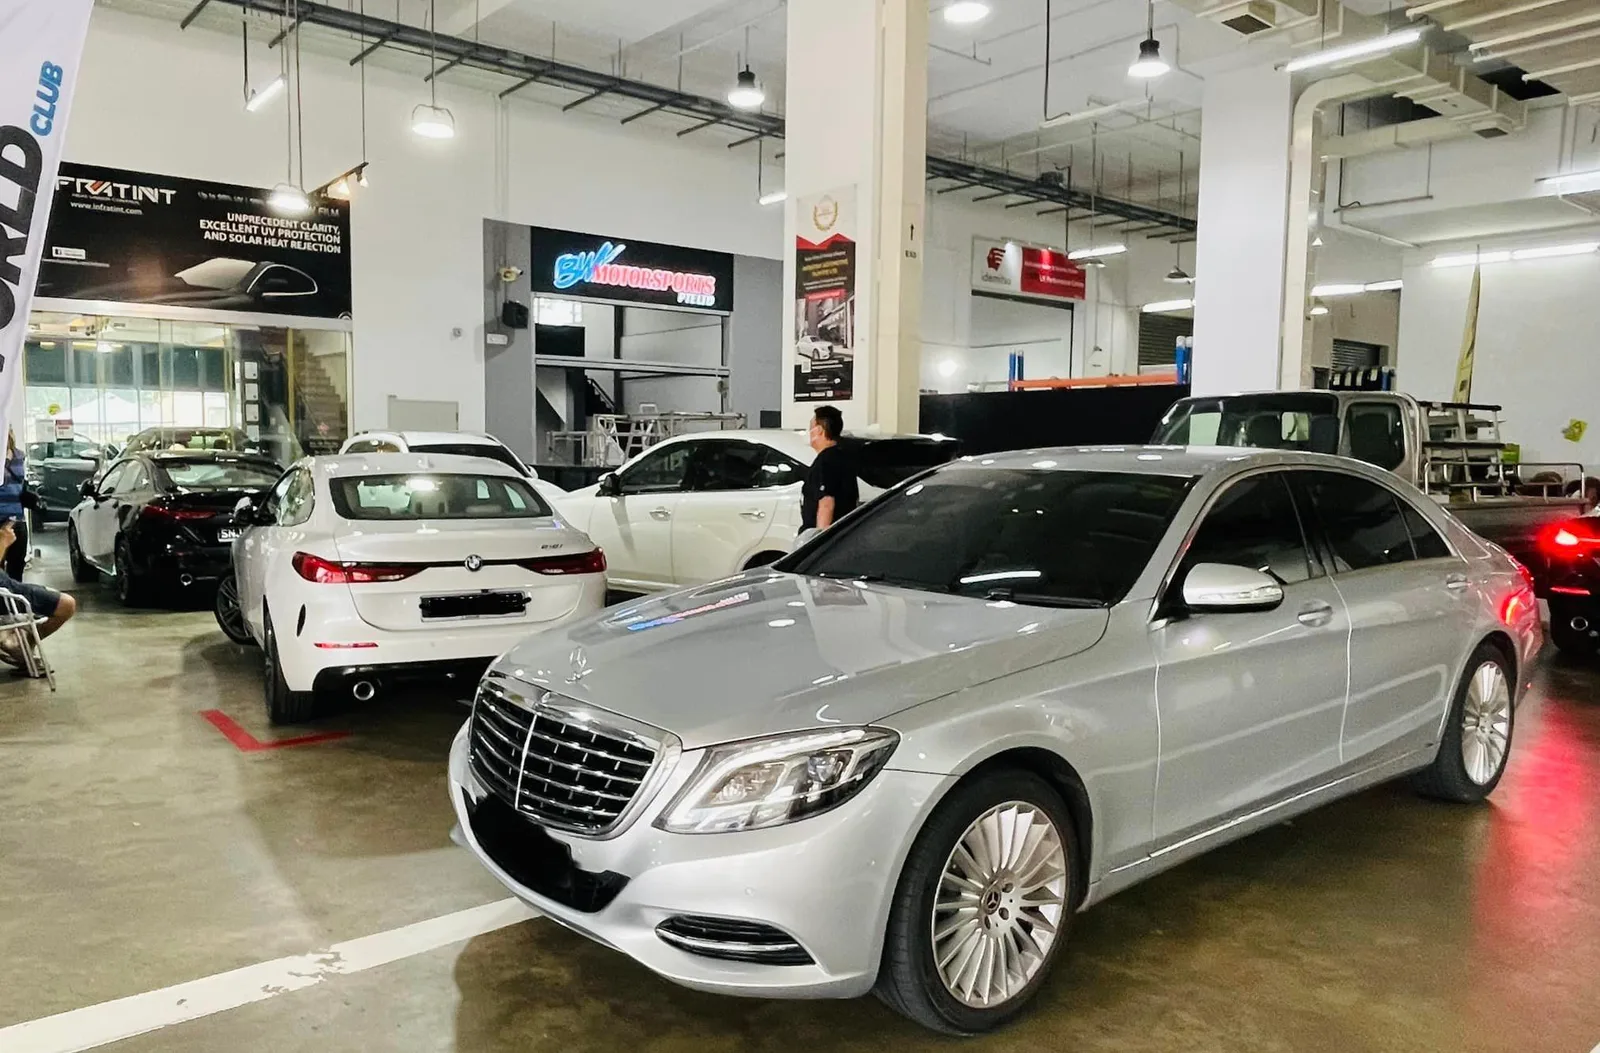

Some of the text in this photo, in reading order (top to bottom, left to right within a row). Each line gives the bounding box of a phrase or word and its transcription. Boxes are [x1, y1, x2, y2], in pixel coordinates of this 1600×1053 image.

[30, 60, 63, 137] CLUB
[70, 201, 143, 215] www.infratint.com
[200, 219, 340, 244] EXCELLENT UV PROTECTION
[227, 212, 340, 235] UNPRECEDENT CLARITY,
[203, 231, 341, 254] AND SOLAR HEAT REJECTION
[592, 264, 716, 295] MOTORSPORTS
